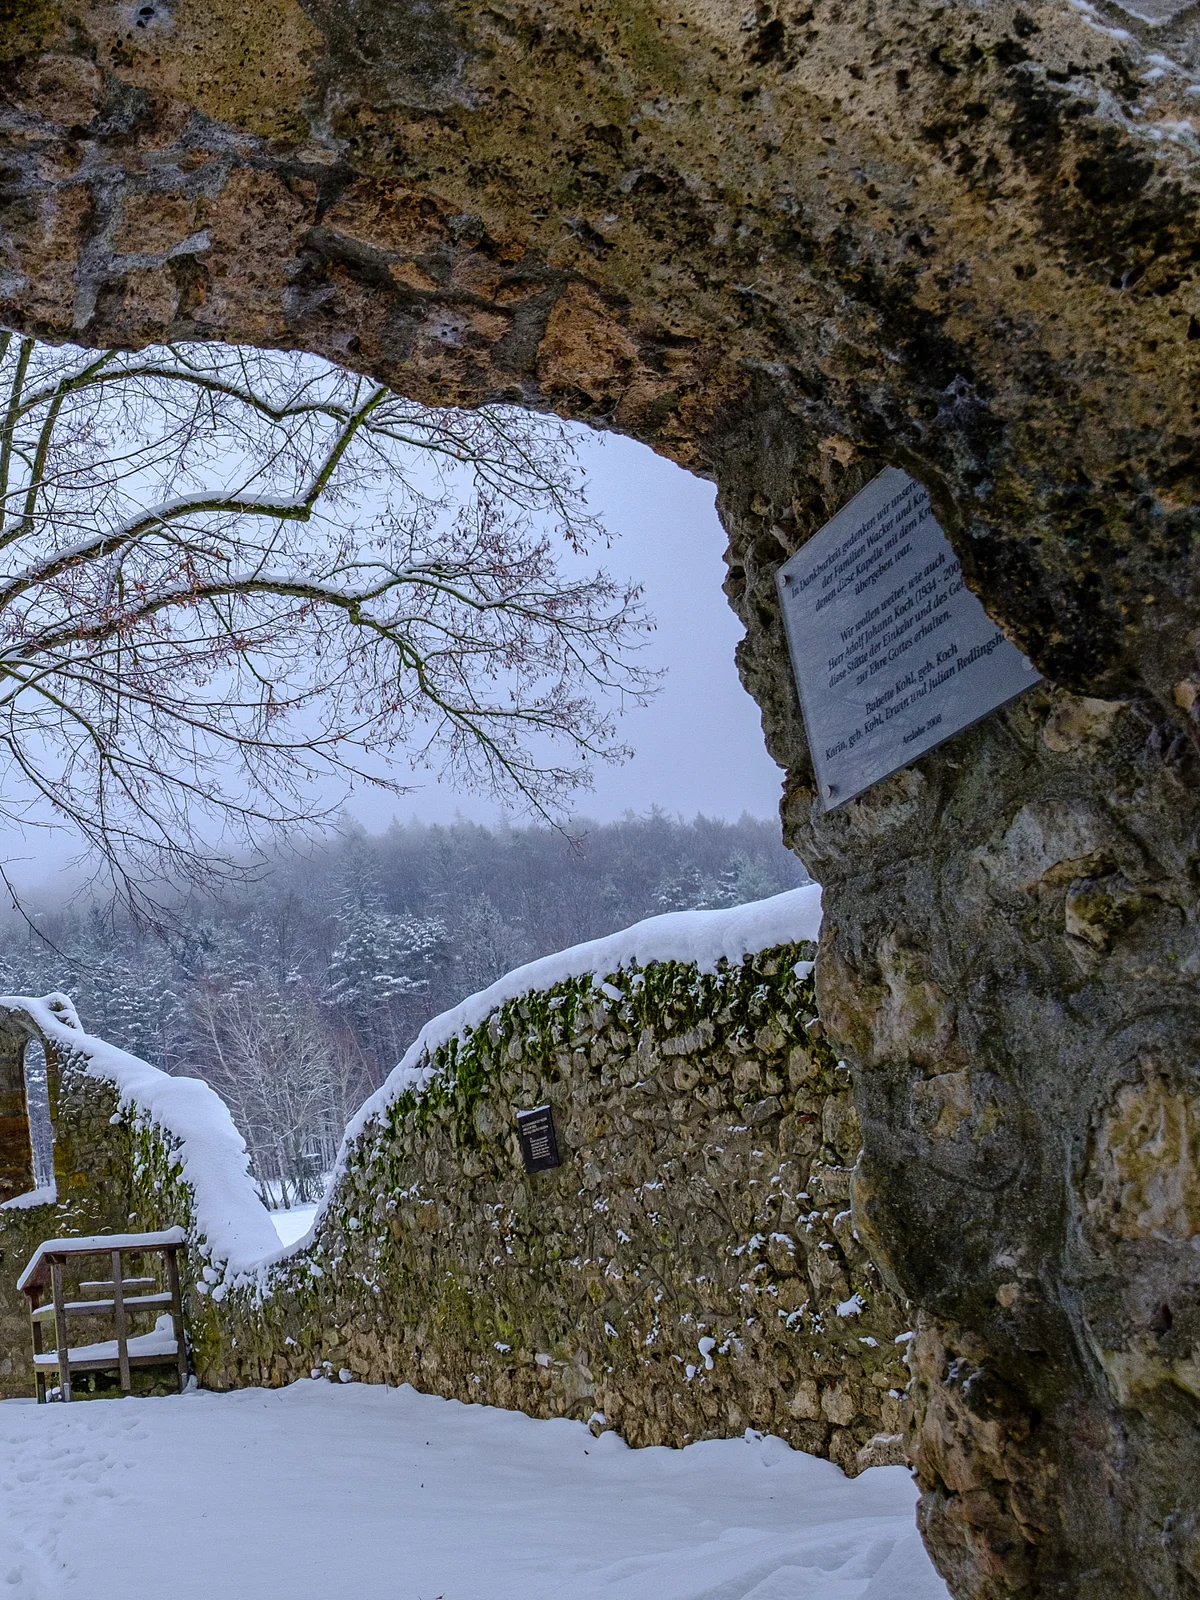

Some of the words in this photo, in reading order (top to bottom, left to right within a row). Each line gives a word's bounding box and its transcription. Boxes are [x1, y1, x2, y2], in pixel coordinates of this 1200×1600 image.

[791, 586, 799, 599] In
[799, 547, 841, 591] Dankbarkeit
[841, 516, 875, 555] gedenken
[876, 502, 890, 521] wir
[815, 588, 836, 612] denen
[836, 571, 854, 593] diese
[855, 547, 882, 577] Kapelle
[883, 532, 898, 552] mit
[899, 518, 917, 539] dem
[821, 572, 833, 588] der
[833, 544, 865, 578] Familien
[865, 518, 893, 548] Wacker
[895, 499, 912, 523] und
[912, 492, 927, 508] Koc
[854, 557, 893, 595] übergeben
[893, 542, 912, 562] war.
[827, 652, 844, 671] Herr
[844, 632, 864, 658] Adolf
[864, 614, 893, 644] Johann
[893, 596, 914, 620] Koch
[914, 577, 936, 604] (1934
[942, 561, 961, 582] 200
[828, 668, 846, 688] diese
[846, 652, 868, 674] Stätte
[868, 641, 881, 657] der
[882, 616, 913, 647] Einkehr
[914, 599, 932, 622] und
[932, 591, 947, 609] des
[839, 626, 854, 642] Wir
[854, 606, 880, 631] wollen
[880, 585, 907, 610] weiter,
[907, 571, 922, 589] wie
[923, 551, 945, 577] auch
[855, 669, 868, 686] zur
[868, 656, 887, 675] Ehre
[887, 637, 913, 661] Gottes
[913, 610, 952, 642] erhalten.
[865, 689, 894, 715] Babette
[894, 670, 916, 694] Kohl,
[917, 659, 935, 682] geb.
[935, 642, 958, 666] Koch
[825, 740, 847, 761] Karin,
[847, 728, 863, 748] geb.
[863, 712, 884, 734] Kohl,
[884, 697, 909, 720] Erwin
[909, 681, 927, 703] und
[928, 665, 955, 693] Julian
[926, 713, 942, 730] 2008
